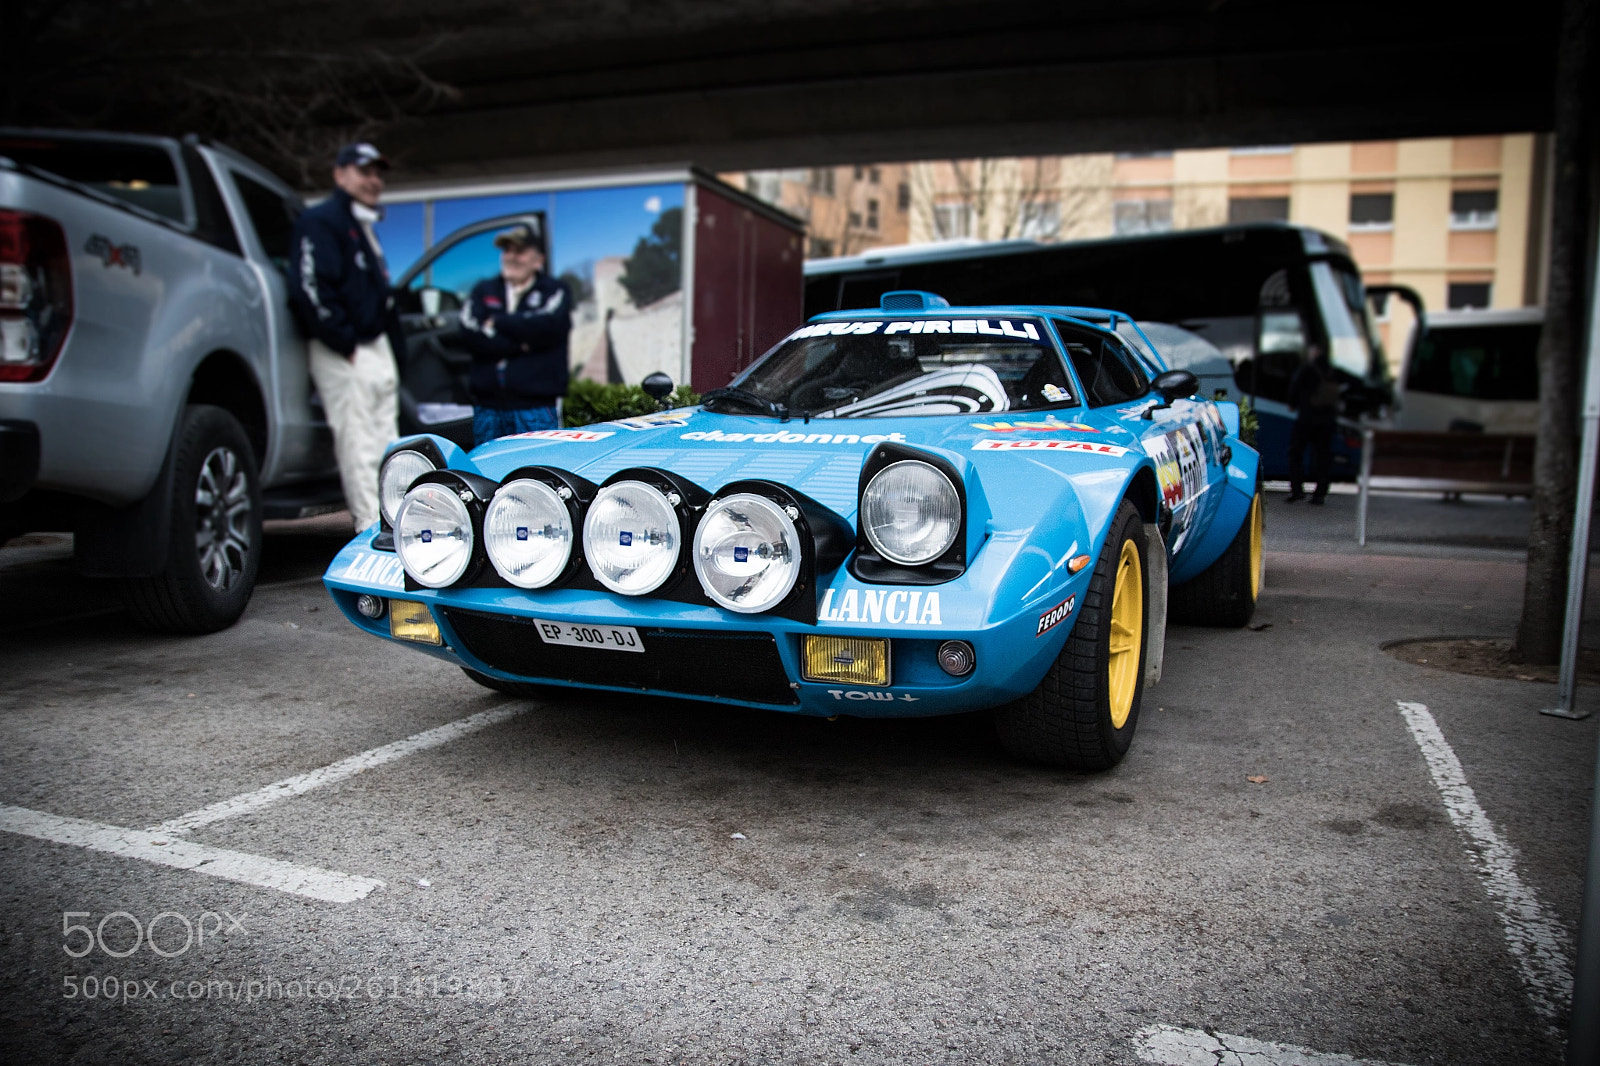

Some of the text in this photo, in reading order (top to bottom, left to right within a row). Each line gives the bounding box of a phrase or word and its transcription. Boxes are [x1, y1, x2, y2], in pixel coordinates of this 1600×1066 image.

[883, 319, 1040, 341] PIRELLI
[680, 430, 907, 444] chardonnet
[987, 441, 1119, 454] TOTAL
[343, 552, 405, 588] LANCI
[817, 588, 942, 625] LANCIA
[1037, 597, 1075, 634] FERODO
[540, 623, 637, 647] EP-300-DJ
[827, 689, 894, 701] TOW
